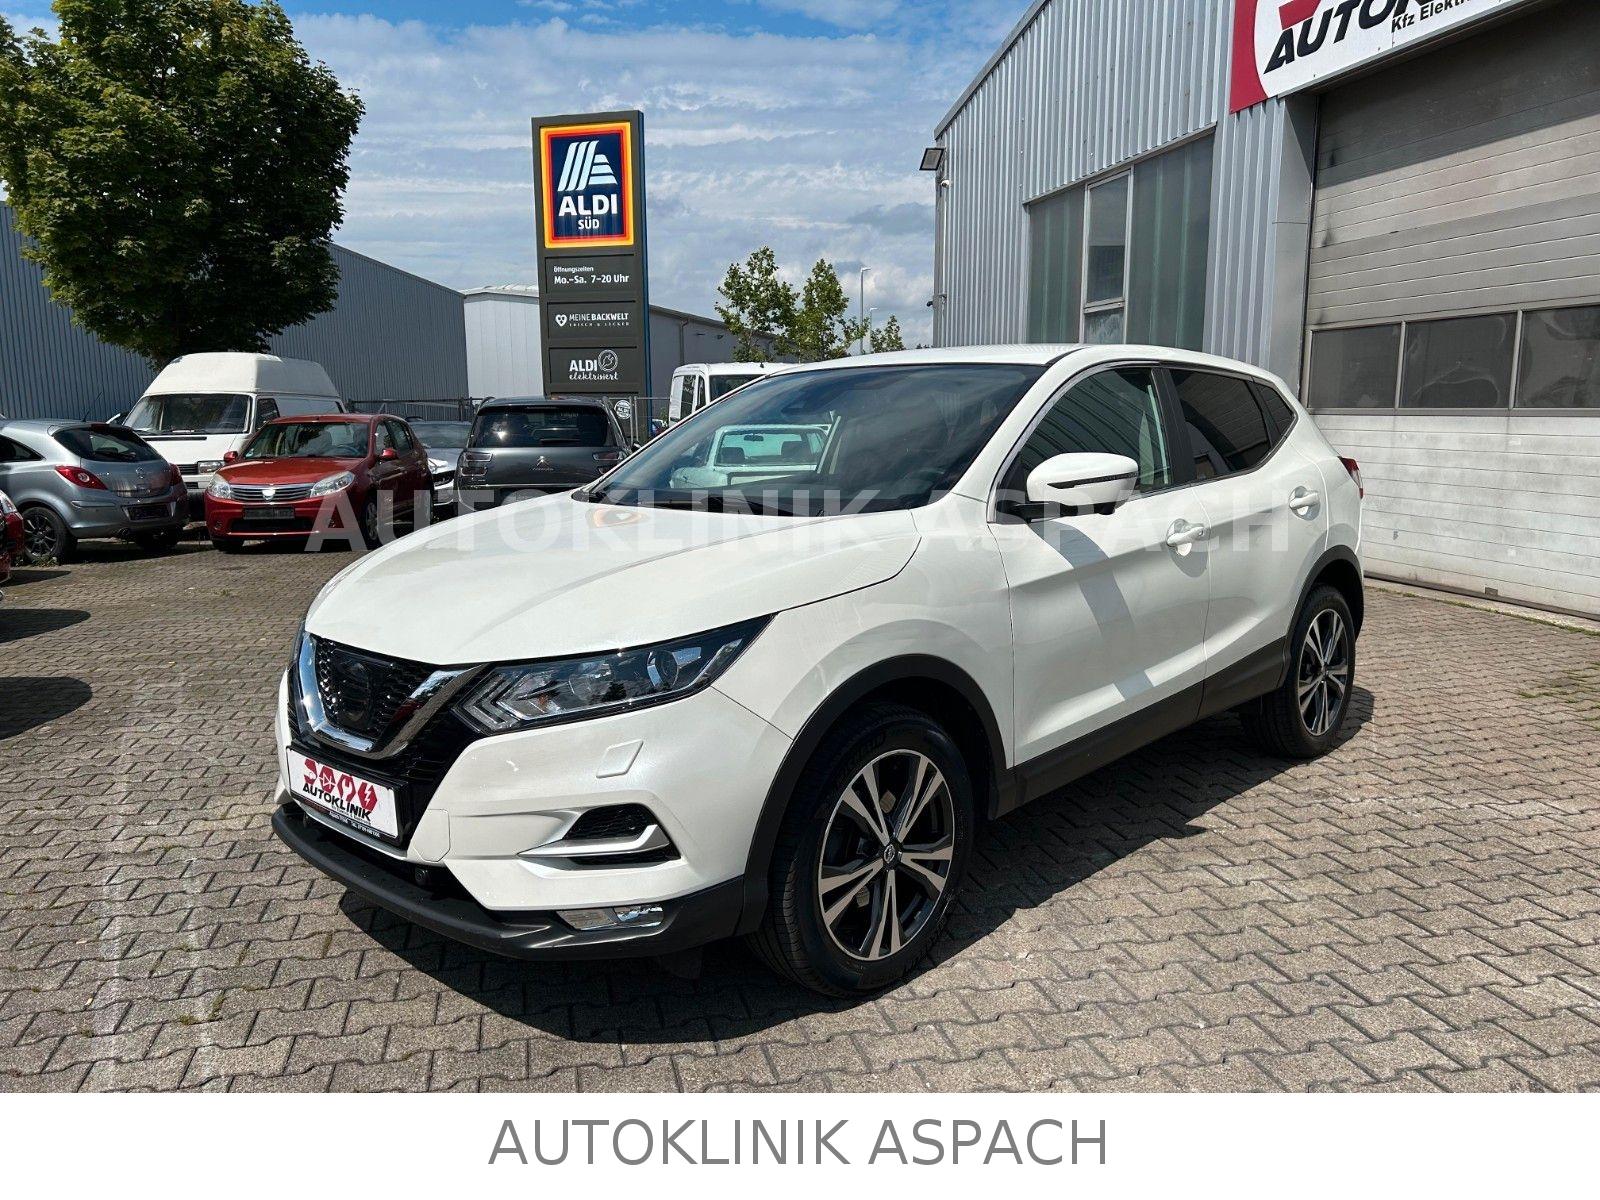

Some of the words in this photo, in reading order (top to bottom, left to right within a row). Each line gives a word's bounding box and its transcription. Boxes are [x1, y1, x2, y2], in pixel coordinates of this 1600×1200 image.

[1391, 13, 1415, 33] Kfz
[559, 193, 618, 216] ALDI
[578, 216, 600, 229] SÜD
[613, 273, 630, 282] Uhr
[569, 360, 598, 371] ALDI
[303, 783, 372, 822] AUTOKLINIK
